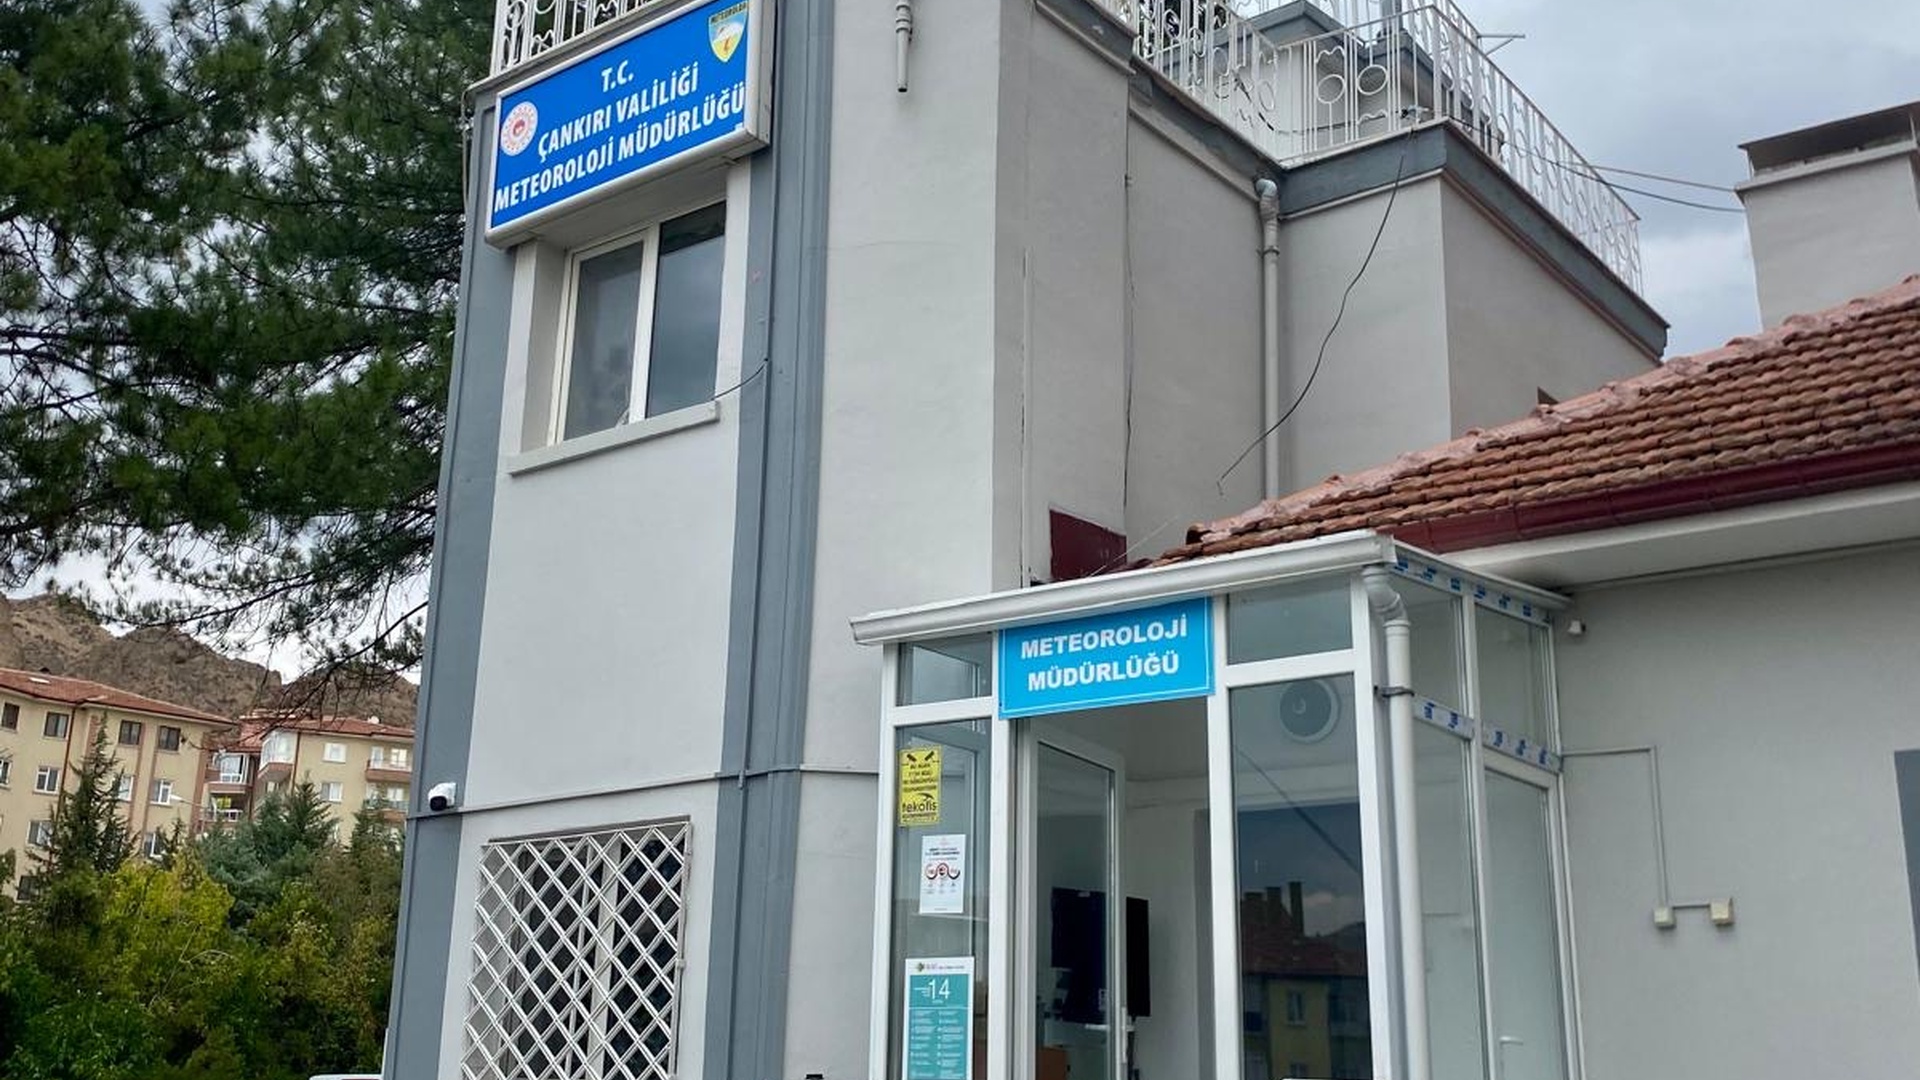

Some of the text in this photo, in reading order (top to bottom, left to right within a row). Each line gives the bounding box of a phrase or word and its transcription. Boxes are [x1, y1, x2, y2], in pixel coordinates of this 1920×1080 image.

[601, 60, 634, 92] T.C.
[538, 61, 699, 163] ÇANKIRI VALİLİĞİ
[494, 82, 745, 212] METEOROLOJİ MÜDÜRLÜĞÜ
[1021, 613, 1189, 660] METEOROLOJİ
[1028, 650, 1180, 692] MÜDÜRLÜĞÜ
[902, 801, 937, 813] tekofis
[928, 978, 951, 1000] 14
